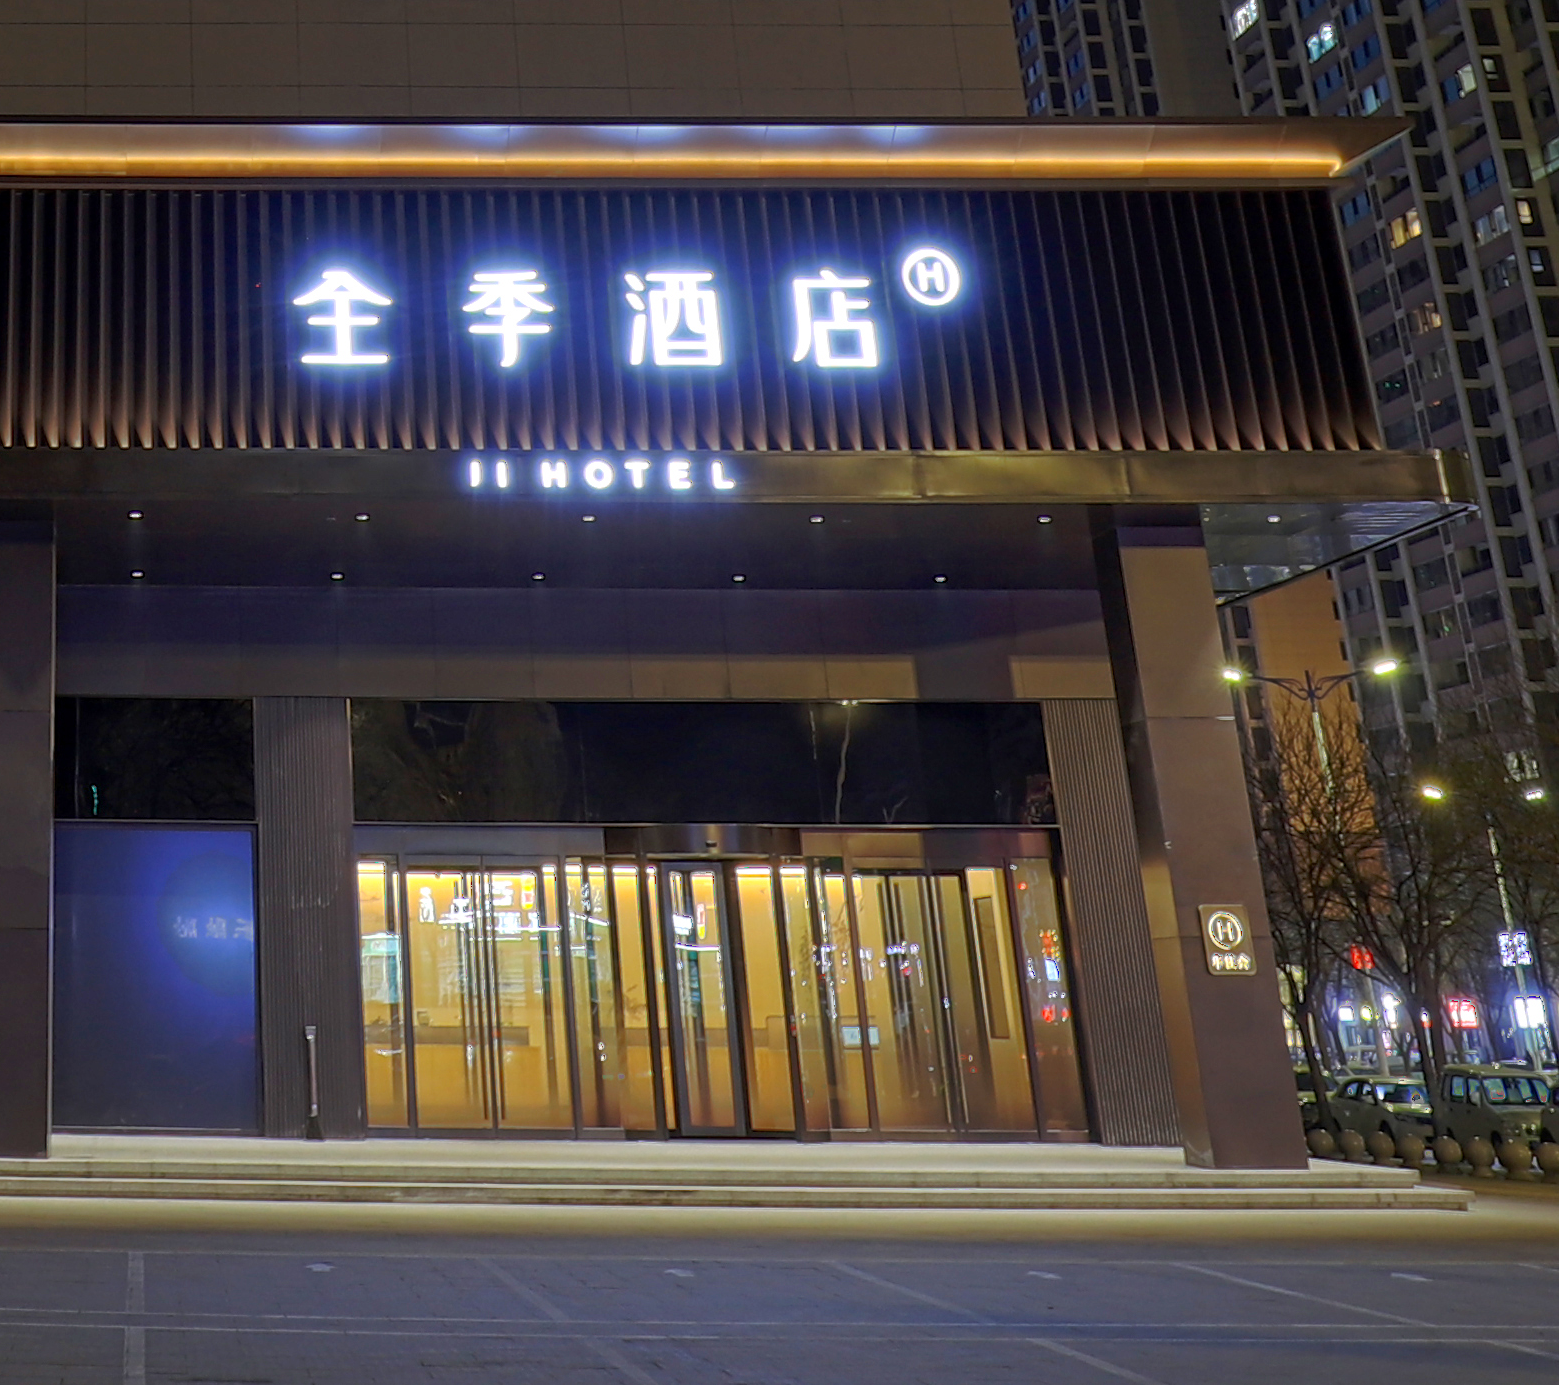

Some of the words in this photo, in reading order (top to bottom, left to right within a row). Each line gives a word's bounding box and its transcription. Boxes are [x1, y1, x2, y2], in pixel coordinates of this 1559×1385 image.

[292, 265, 880, 369] 全季酒店
[539, 459, 737, 490] HOTEL
